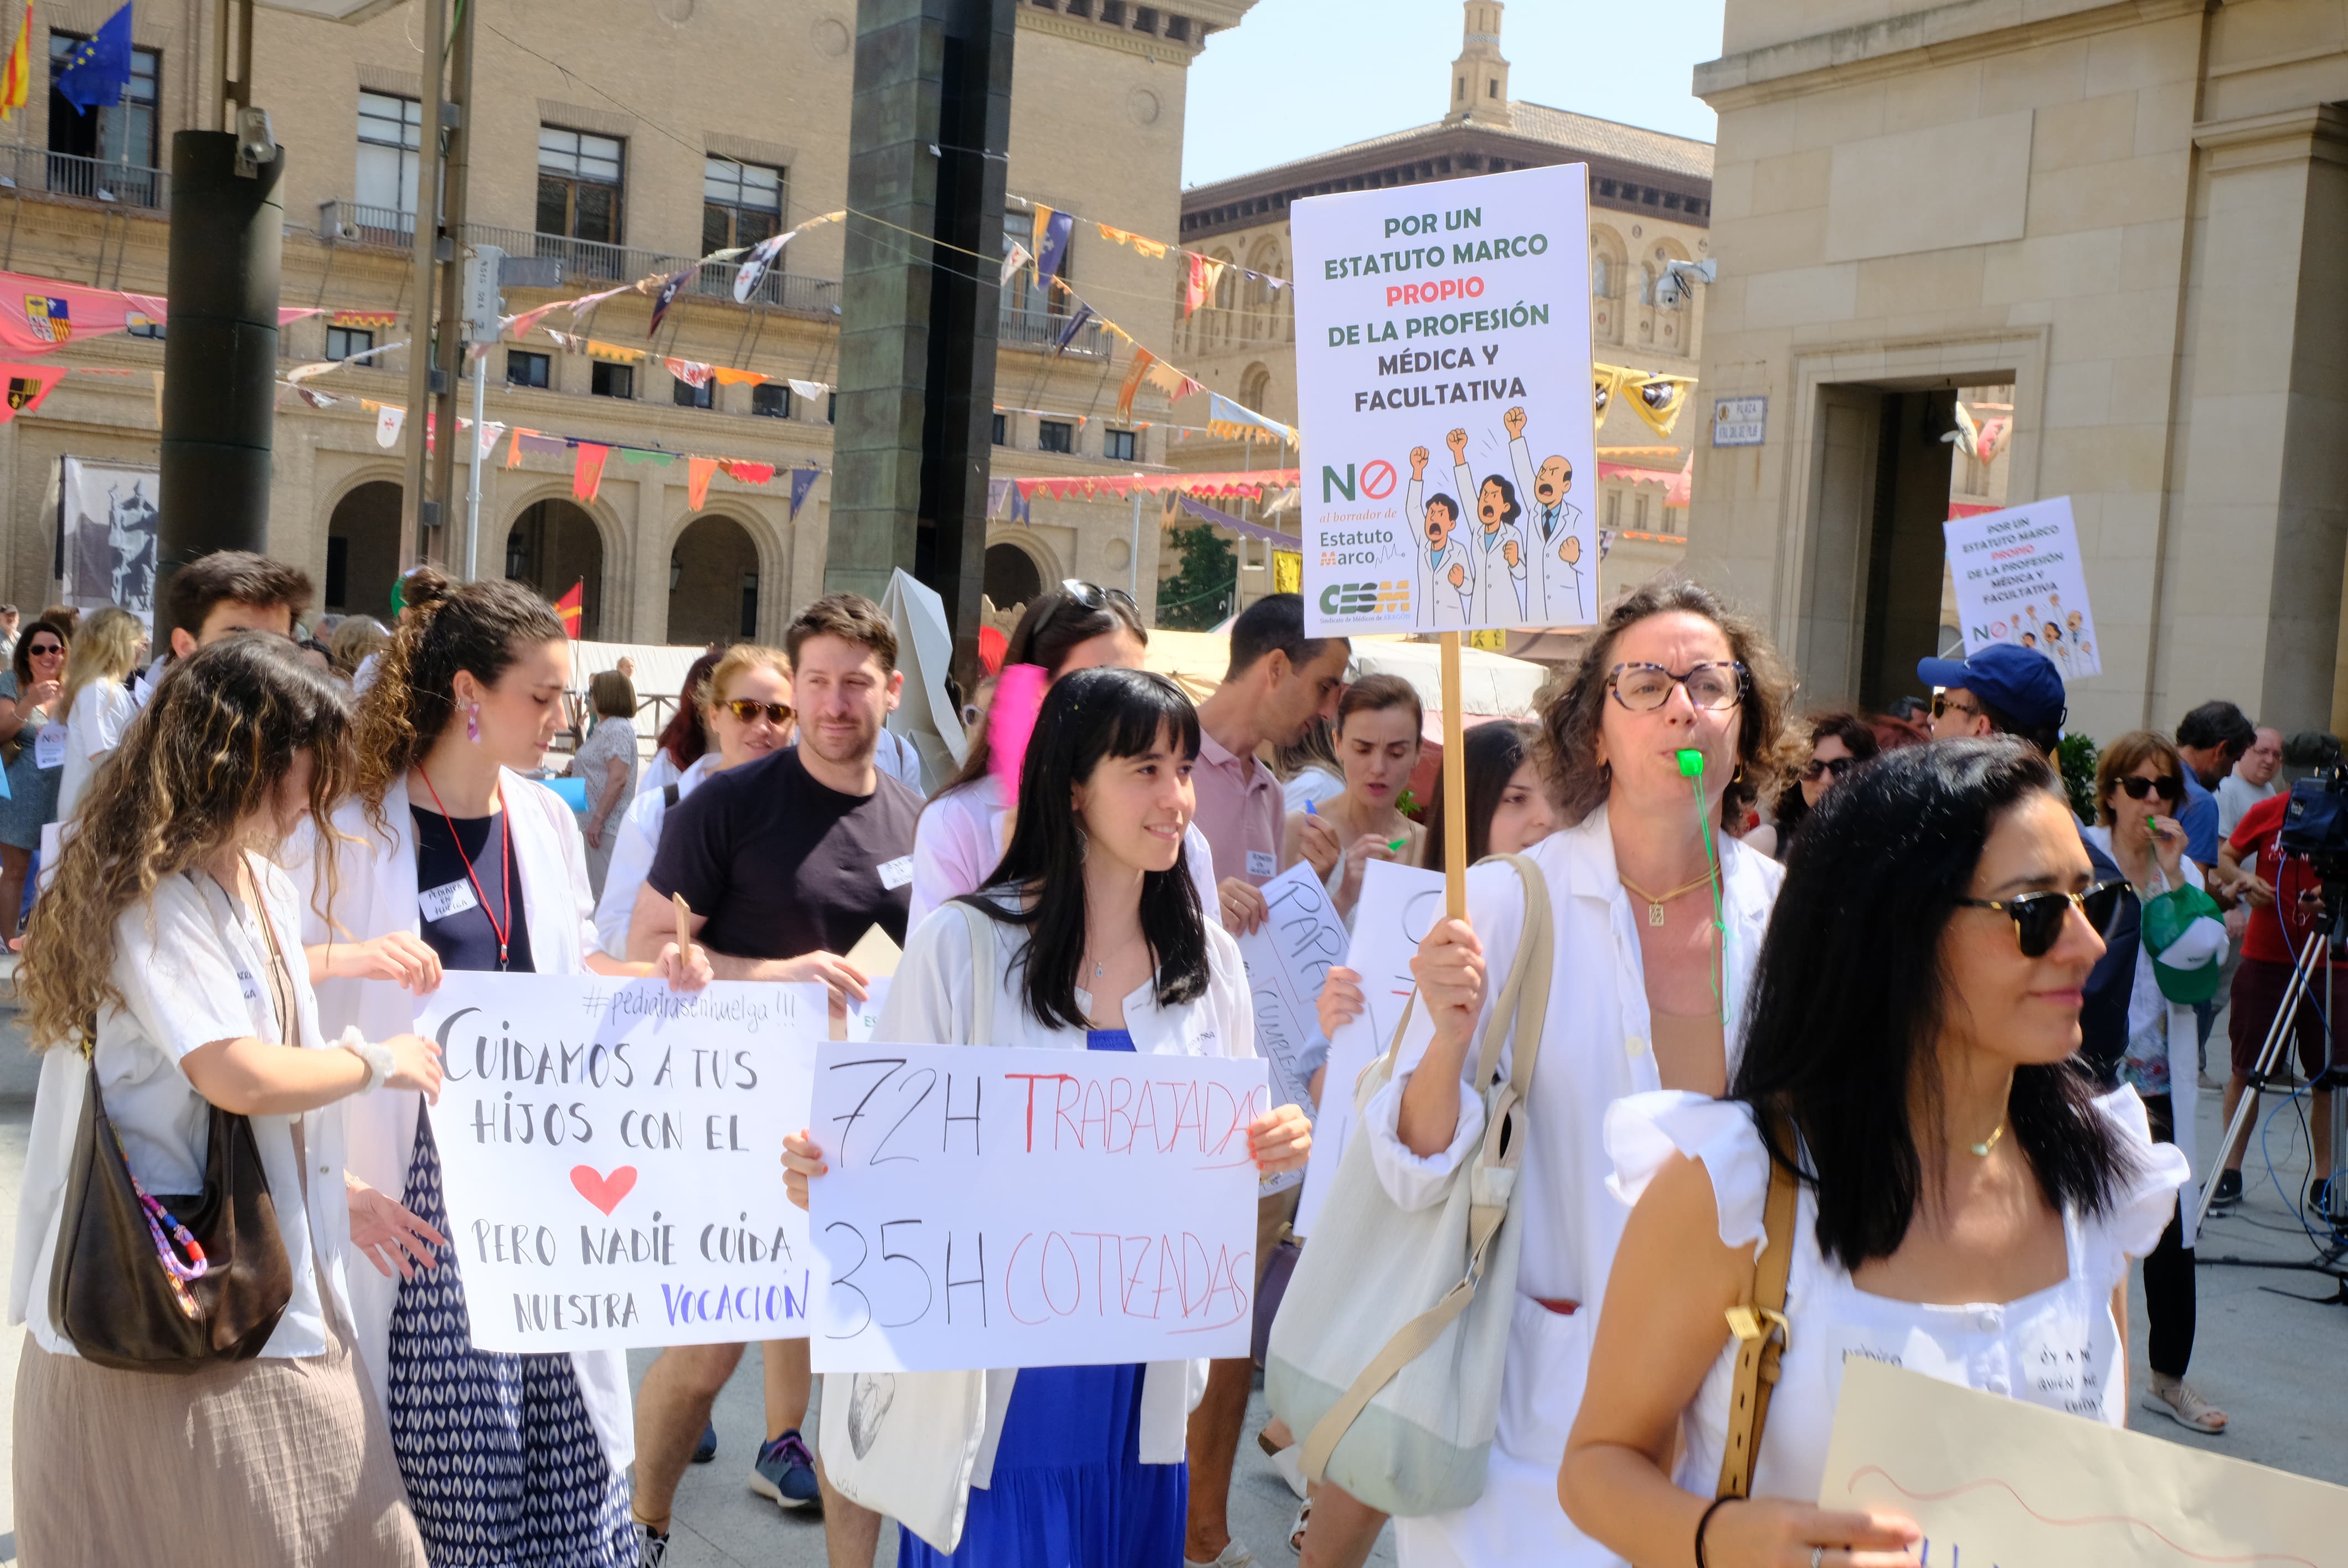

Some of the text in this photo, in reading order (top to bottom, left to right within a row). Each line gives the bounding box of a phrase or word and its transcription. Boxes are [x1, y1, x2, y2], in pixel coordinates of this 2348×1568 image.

[1384, 207, 1481, 238] POR UN
[1325, 234, 1548, 280] ESTATUTO MARCO
[1386, 276, 1484, 307] PROPIO
[1329, 300, 1549, 347] DE LA PROFESIÓN
[1378, 345, 1499, 376] MÉDICA Y
[1355, 376, 1527, 412] FACULTATIVA
[1320, 507, 1397, 523] al borrador de
[1987, 517, 2030, 535] POR UN
[1321, 529, 1393, 546] Estatuto
[1962, 525, 2060, 554] ESTATUTO MARCO
[1320, 551, 1374, 566] Marco
[1966, 569, 1983, 580] DE
[1985, 565, 2000, 576] LA
[1320, 580, 1410, 615] CESM
[1983, 581, 2059, 604] FACULTATIVA
[436, 1007, 758, 1090] CUIDAMOS A TUS
[470, 1091, 749, 1152] HIJOS CON EL
[472, 1211, 792, 1266] PERO NADIE CUIDA
[513, 1292, 639, 1332] NUESTRA
